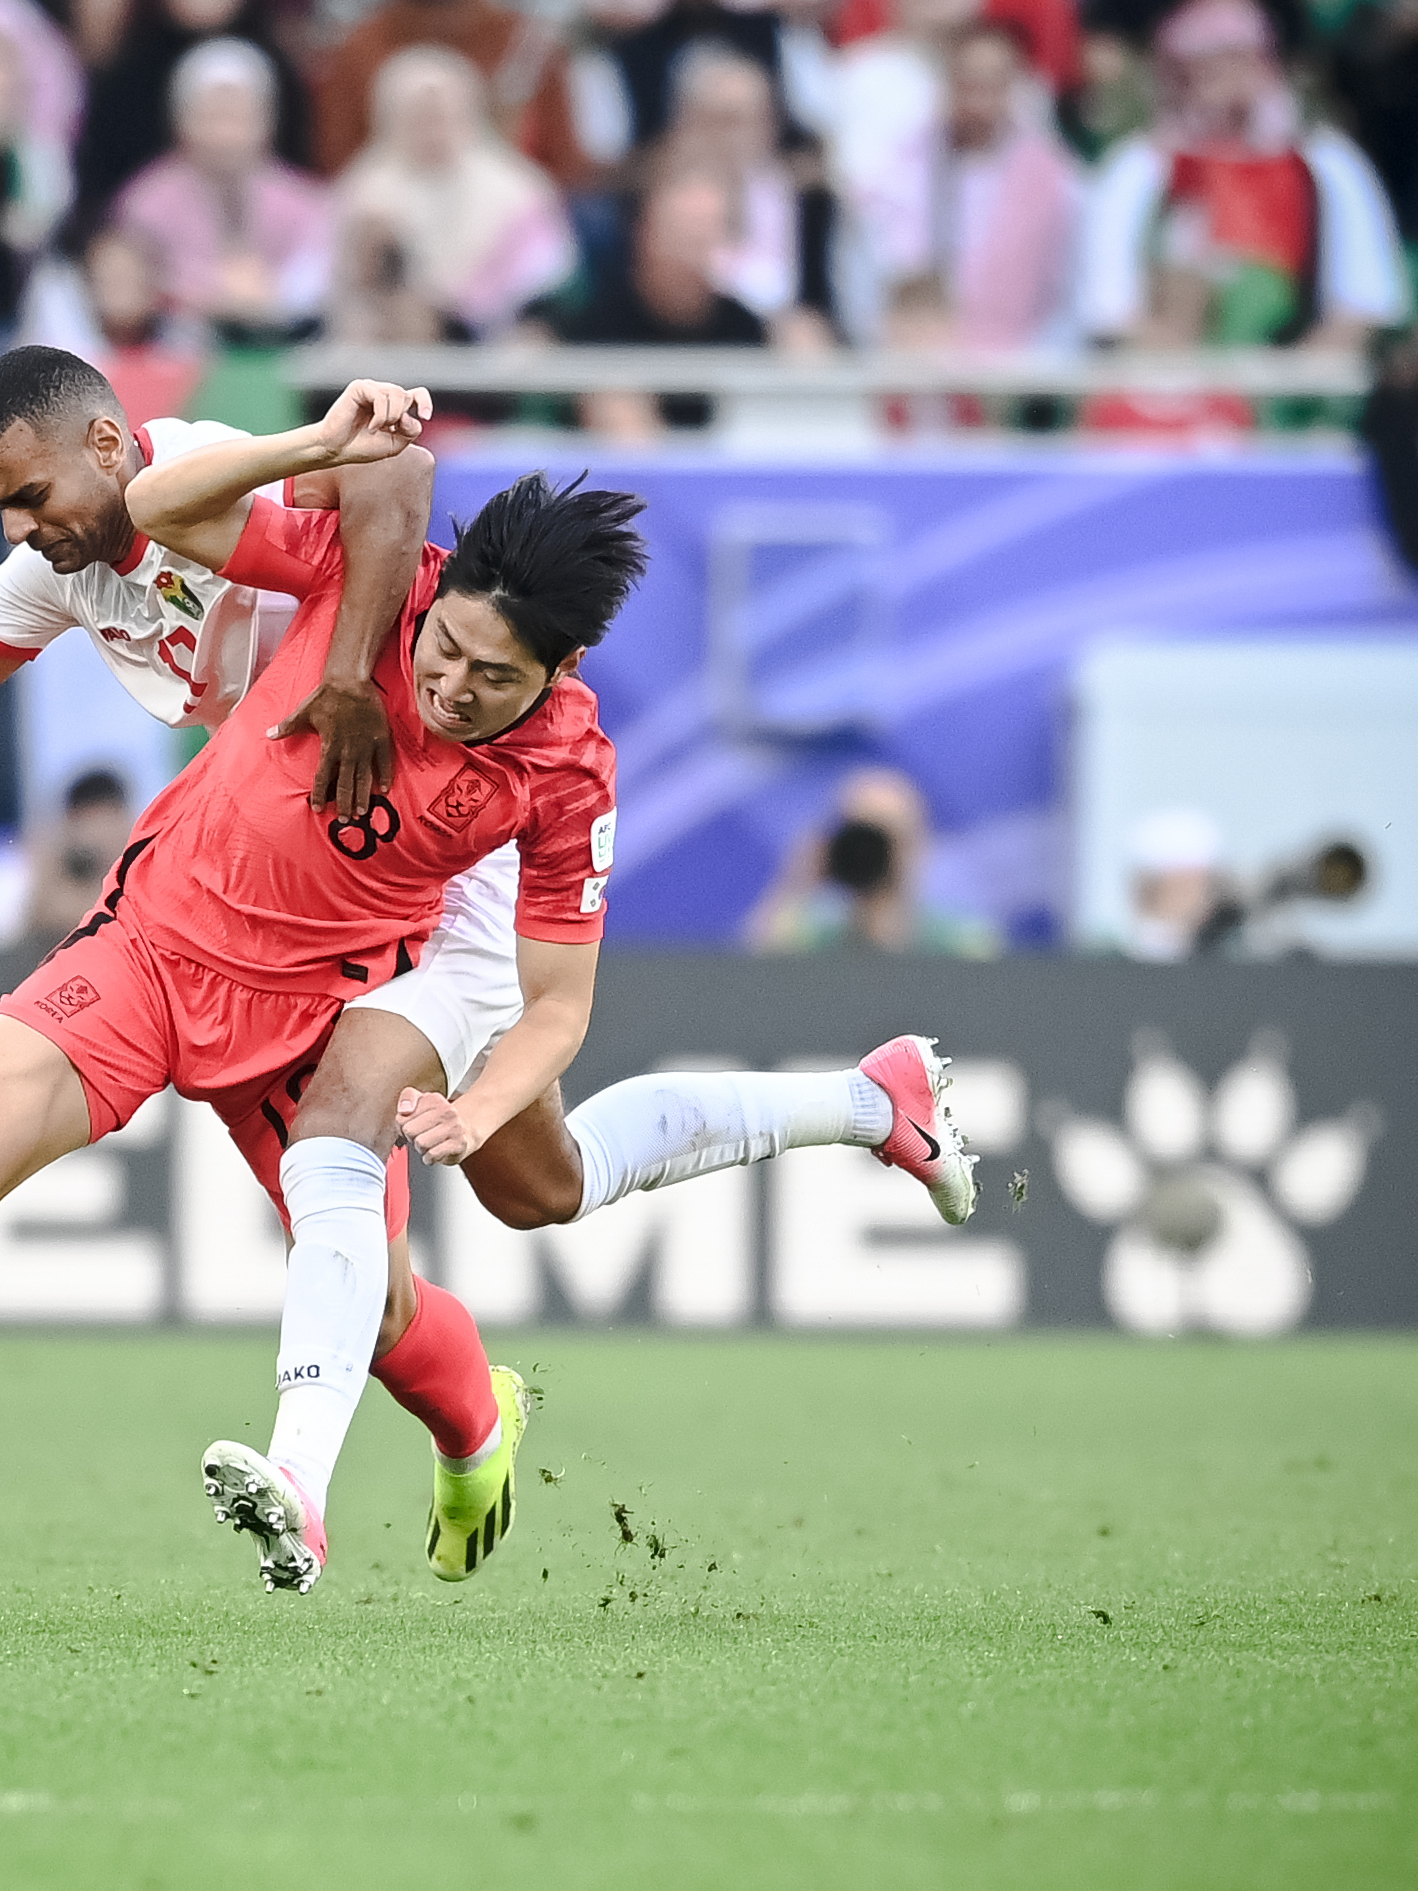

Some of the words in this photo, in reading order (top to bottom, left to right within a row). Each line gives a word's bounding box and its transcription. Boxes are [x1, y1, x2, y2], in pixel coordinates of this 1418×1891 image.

[306, 794, 400, 860] 8
[33, 1000, 63, 1024] KOREA
[275, 1364, 320, 1390] JAKO
